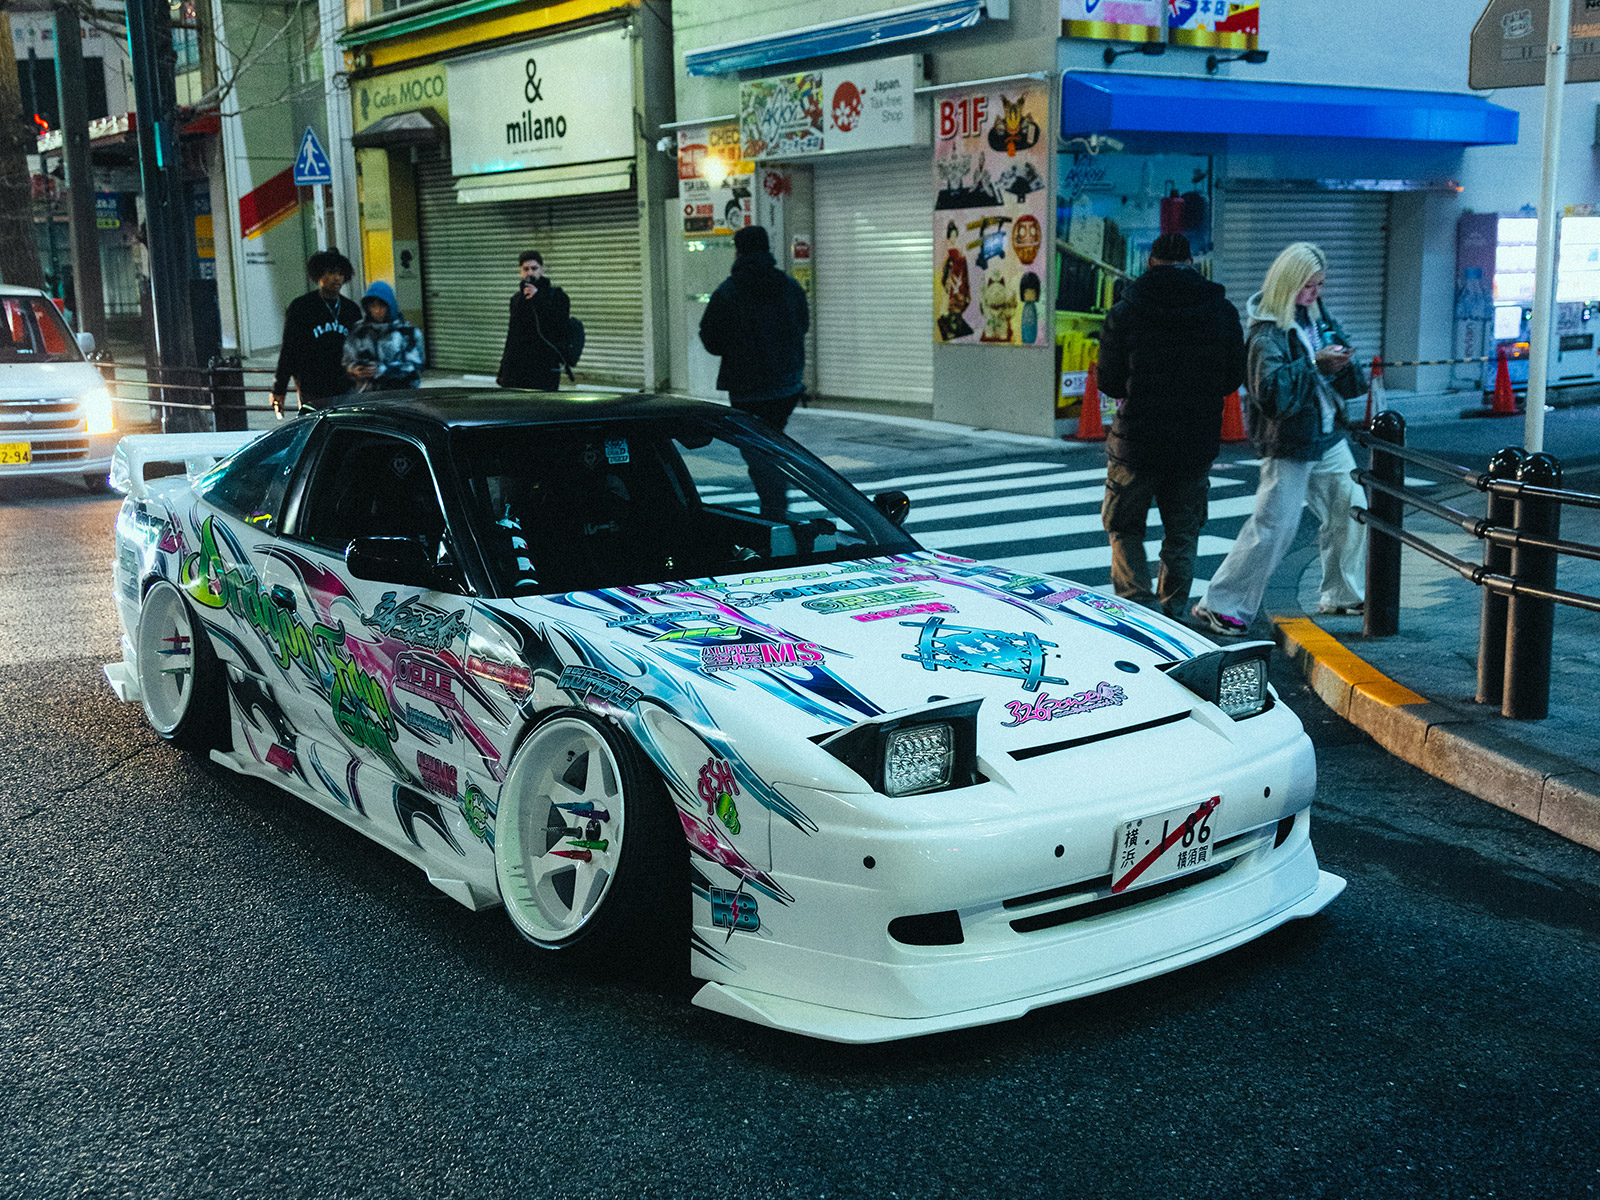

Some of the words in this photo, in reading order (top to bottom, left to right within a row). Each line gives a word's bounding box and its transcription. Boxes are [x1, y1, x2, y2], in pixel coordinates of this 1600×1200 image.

[400, 75, 444, 102] MOCO
[524, 58, 543, 103] &
[506, 110, 567, 144] milano
[940, 97, 988, 140] B1F
[771, 576, 896, 600] ORIGIN
[702, 645, 760, 657] ALPHA
[759, 642, 824, 664] MS
[556, 664, 645, 710] HUMBLE
[1000, 681, 1128, 728] 326power
[1120, 828, 1139, 869] 横浜
[1177, 844, 1209, 870] 横須賀
